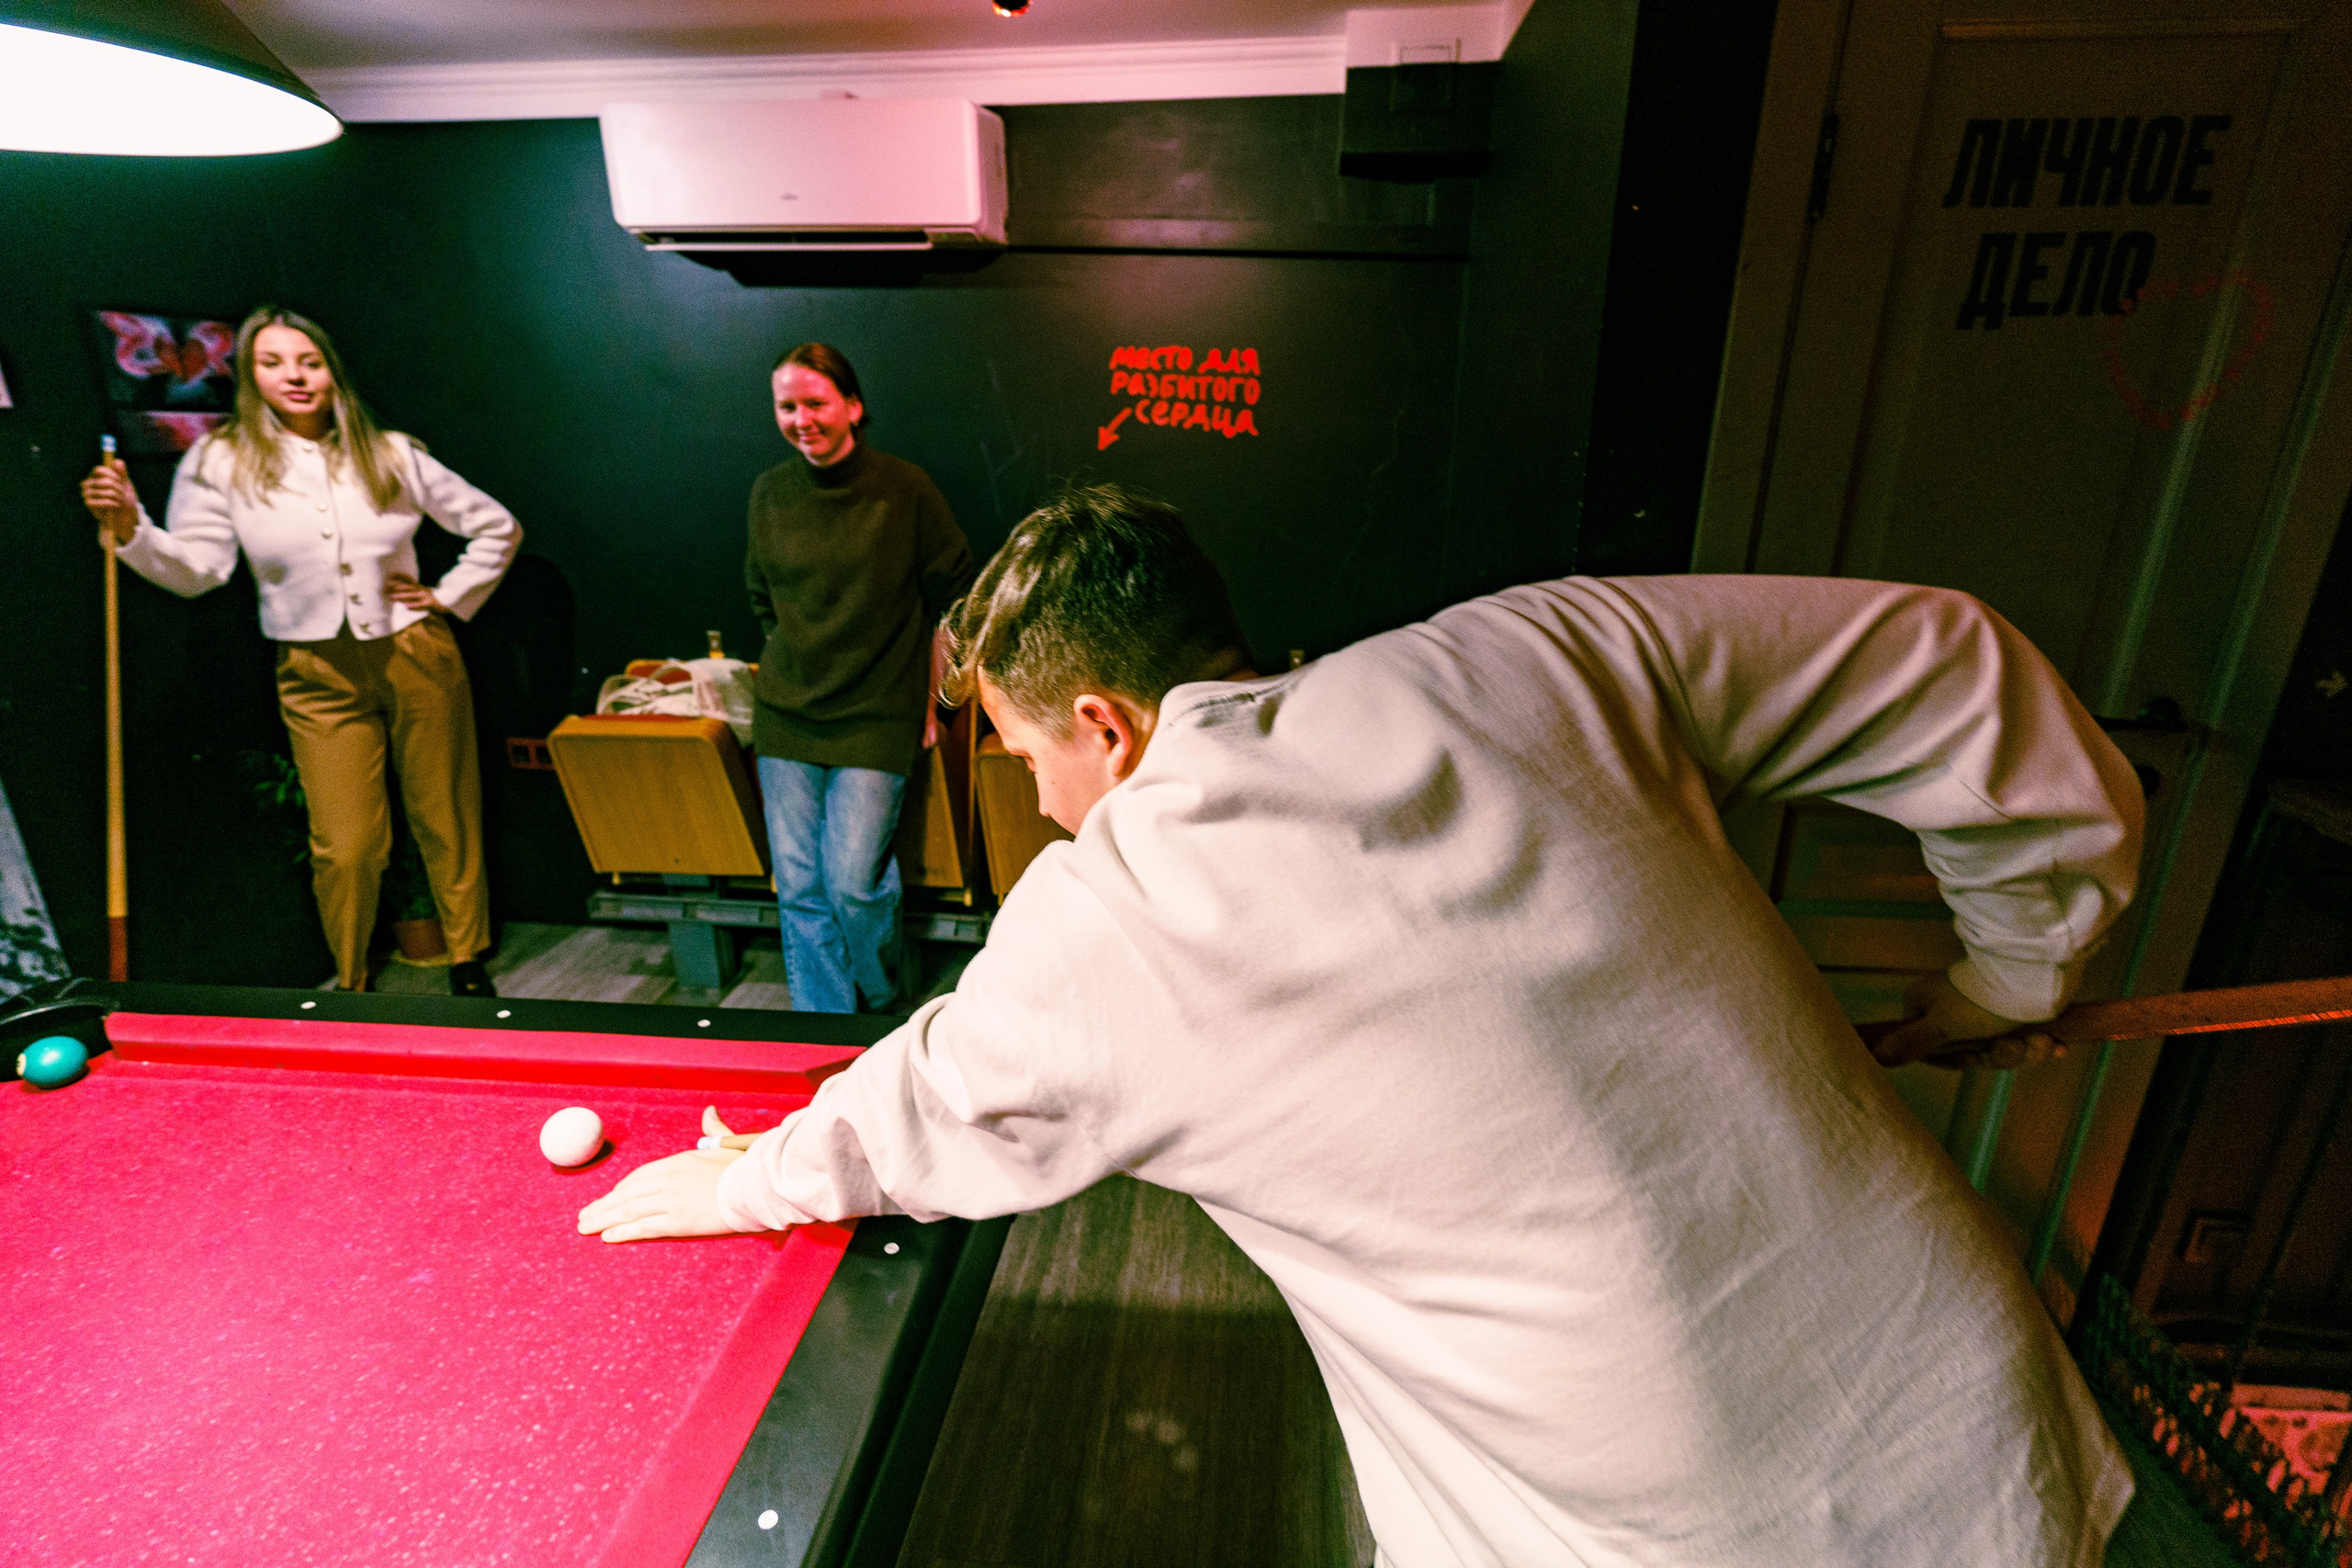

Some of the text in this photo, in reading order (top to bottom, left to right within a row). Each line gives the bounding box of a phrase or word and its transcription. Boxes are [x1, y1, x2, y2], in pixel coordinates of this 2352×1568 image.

[1942, 114, 2233, 209] ЛИЧНОЕ
[1955, 231, 2156, 331] ДЕЛО
[1109, 345, 1261, 376] МЕСТО ДЛЯ
[1111, 370, 1261, 405] РАЗБИТОГО
